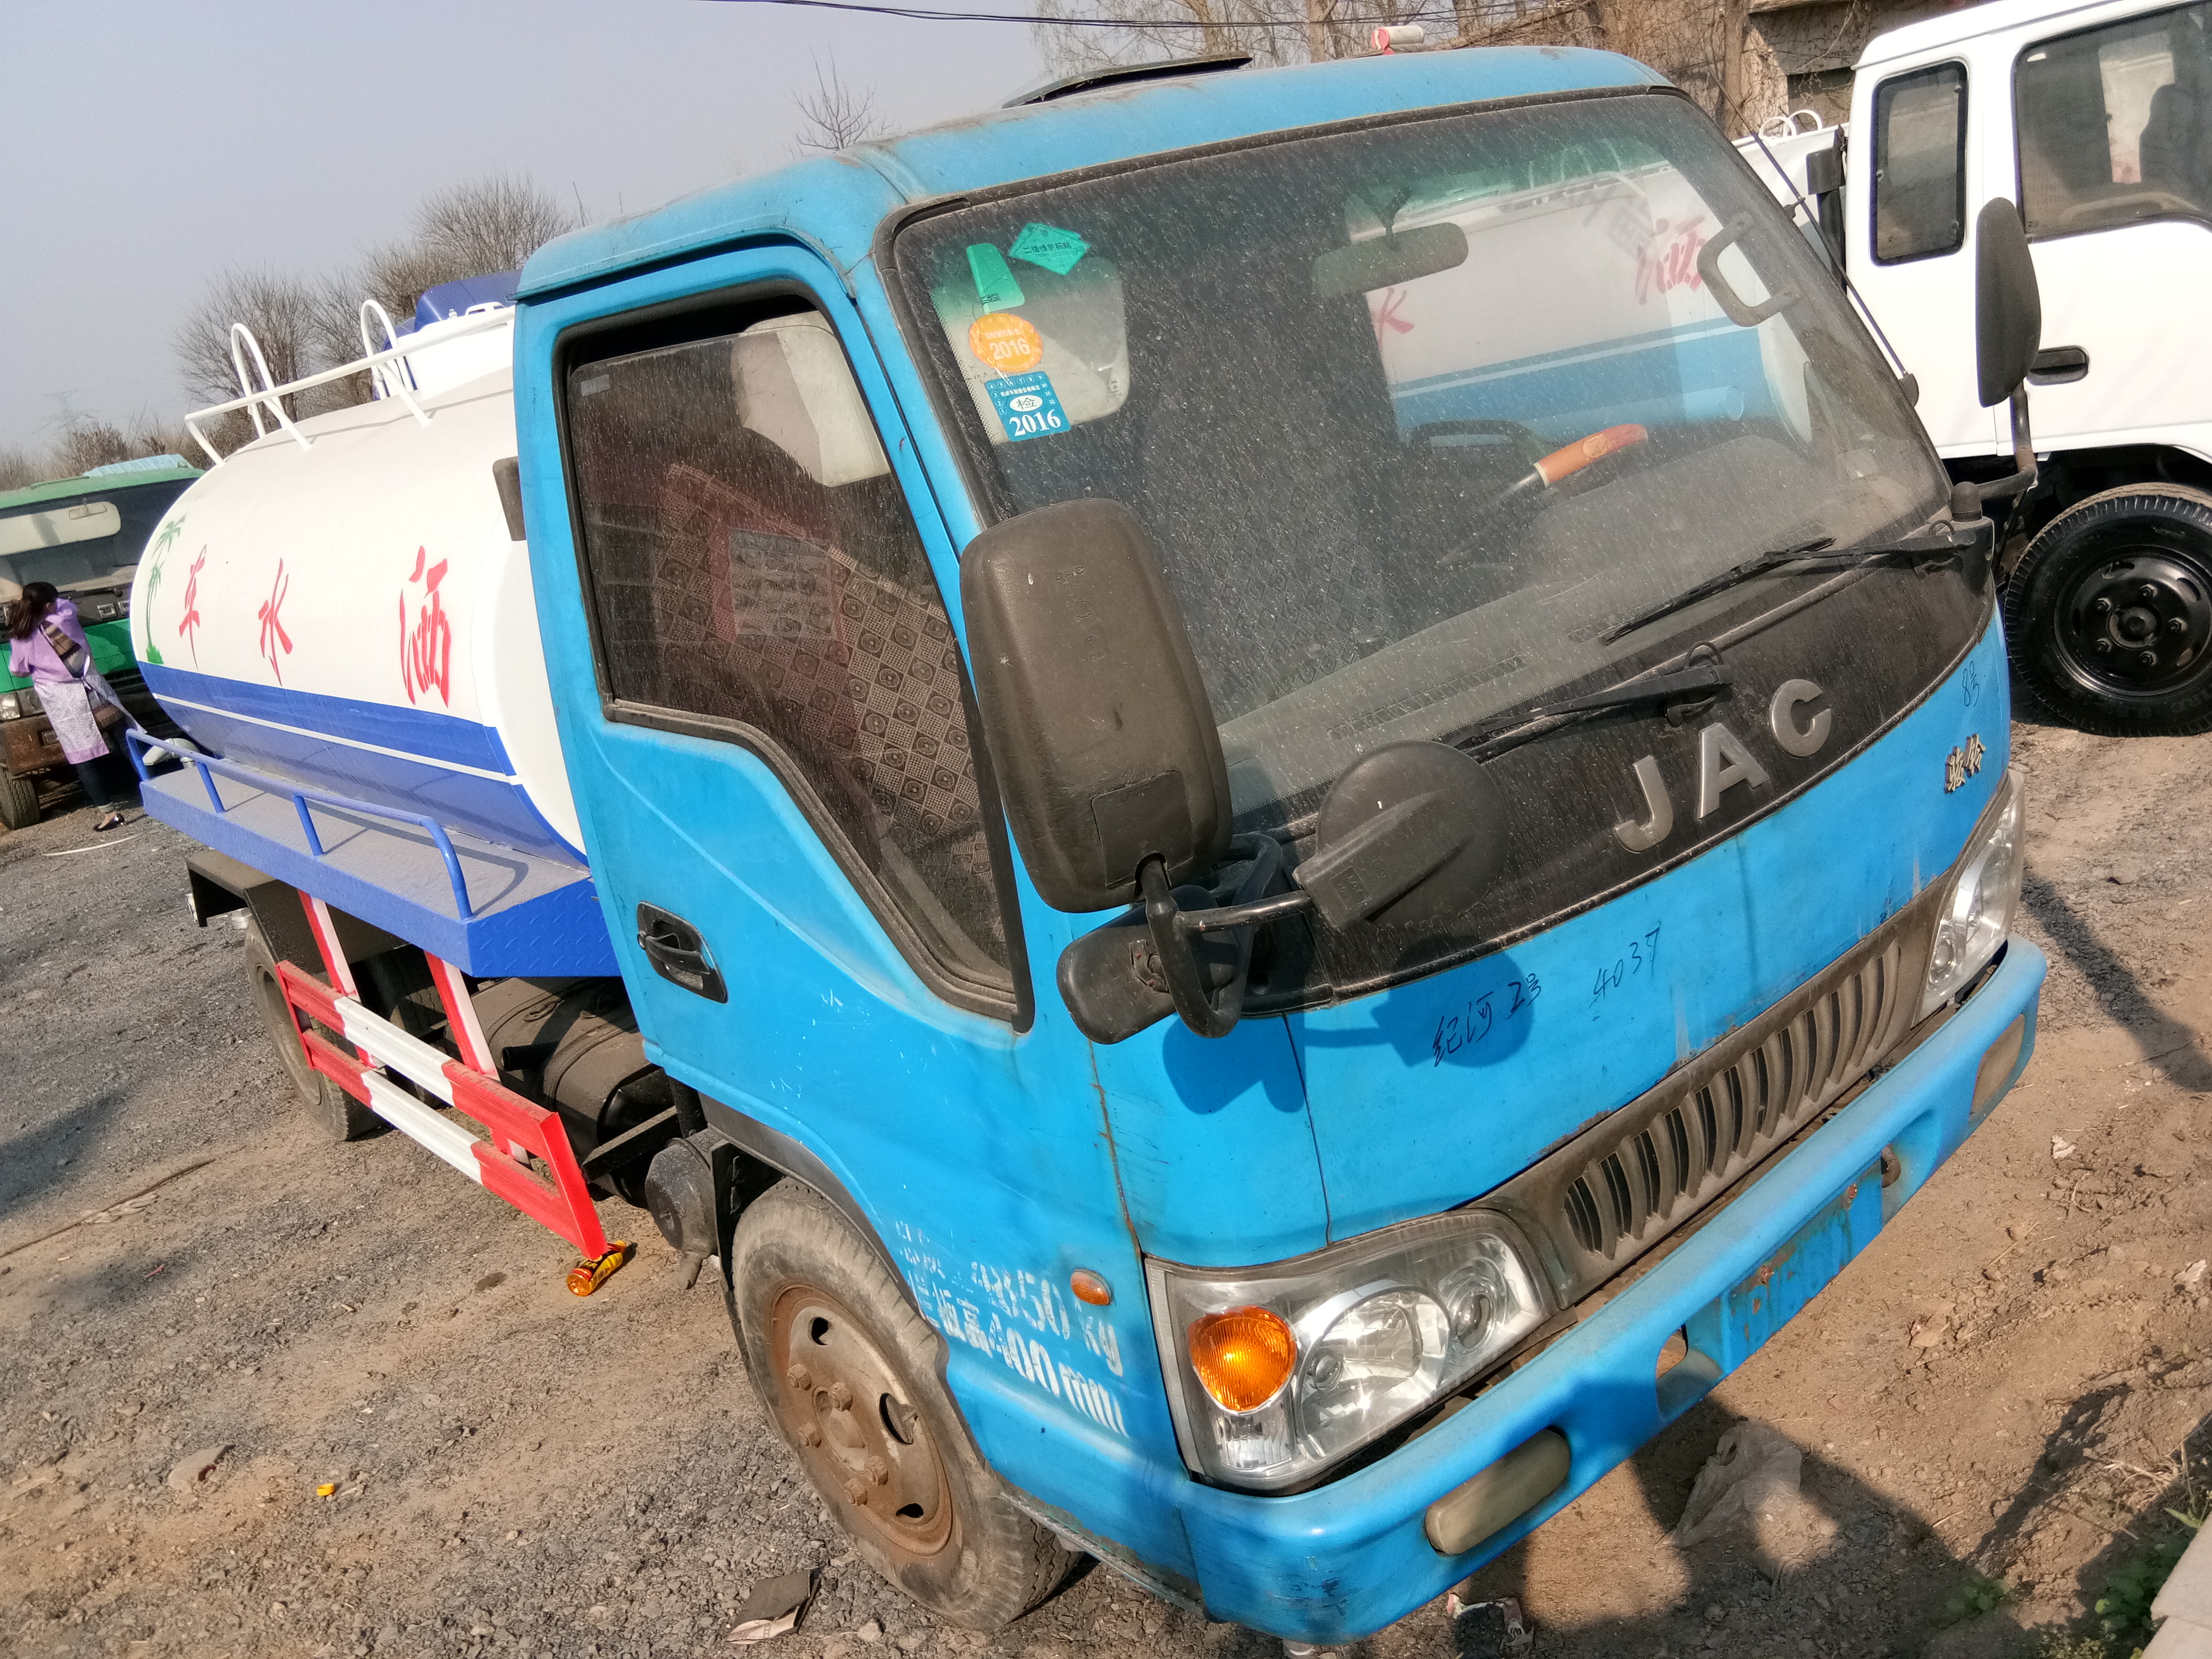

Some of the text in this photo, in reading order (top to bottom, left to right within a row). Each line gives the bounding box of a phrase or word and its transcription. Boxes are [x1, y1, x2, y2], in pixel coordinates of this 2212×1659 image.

[990, 338, 1030, 360] 2016
[1016, 397, 1037, 410] 检
[1009, 409, 1061, 437] 2016
[1613, 678, 1832, 853] JAC
